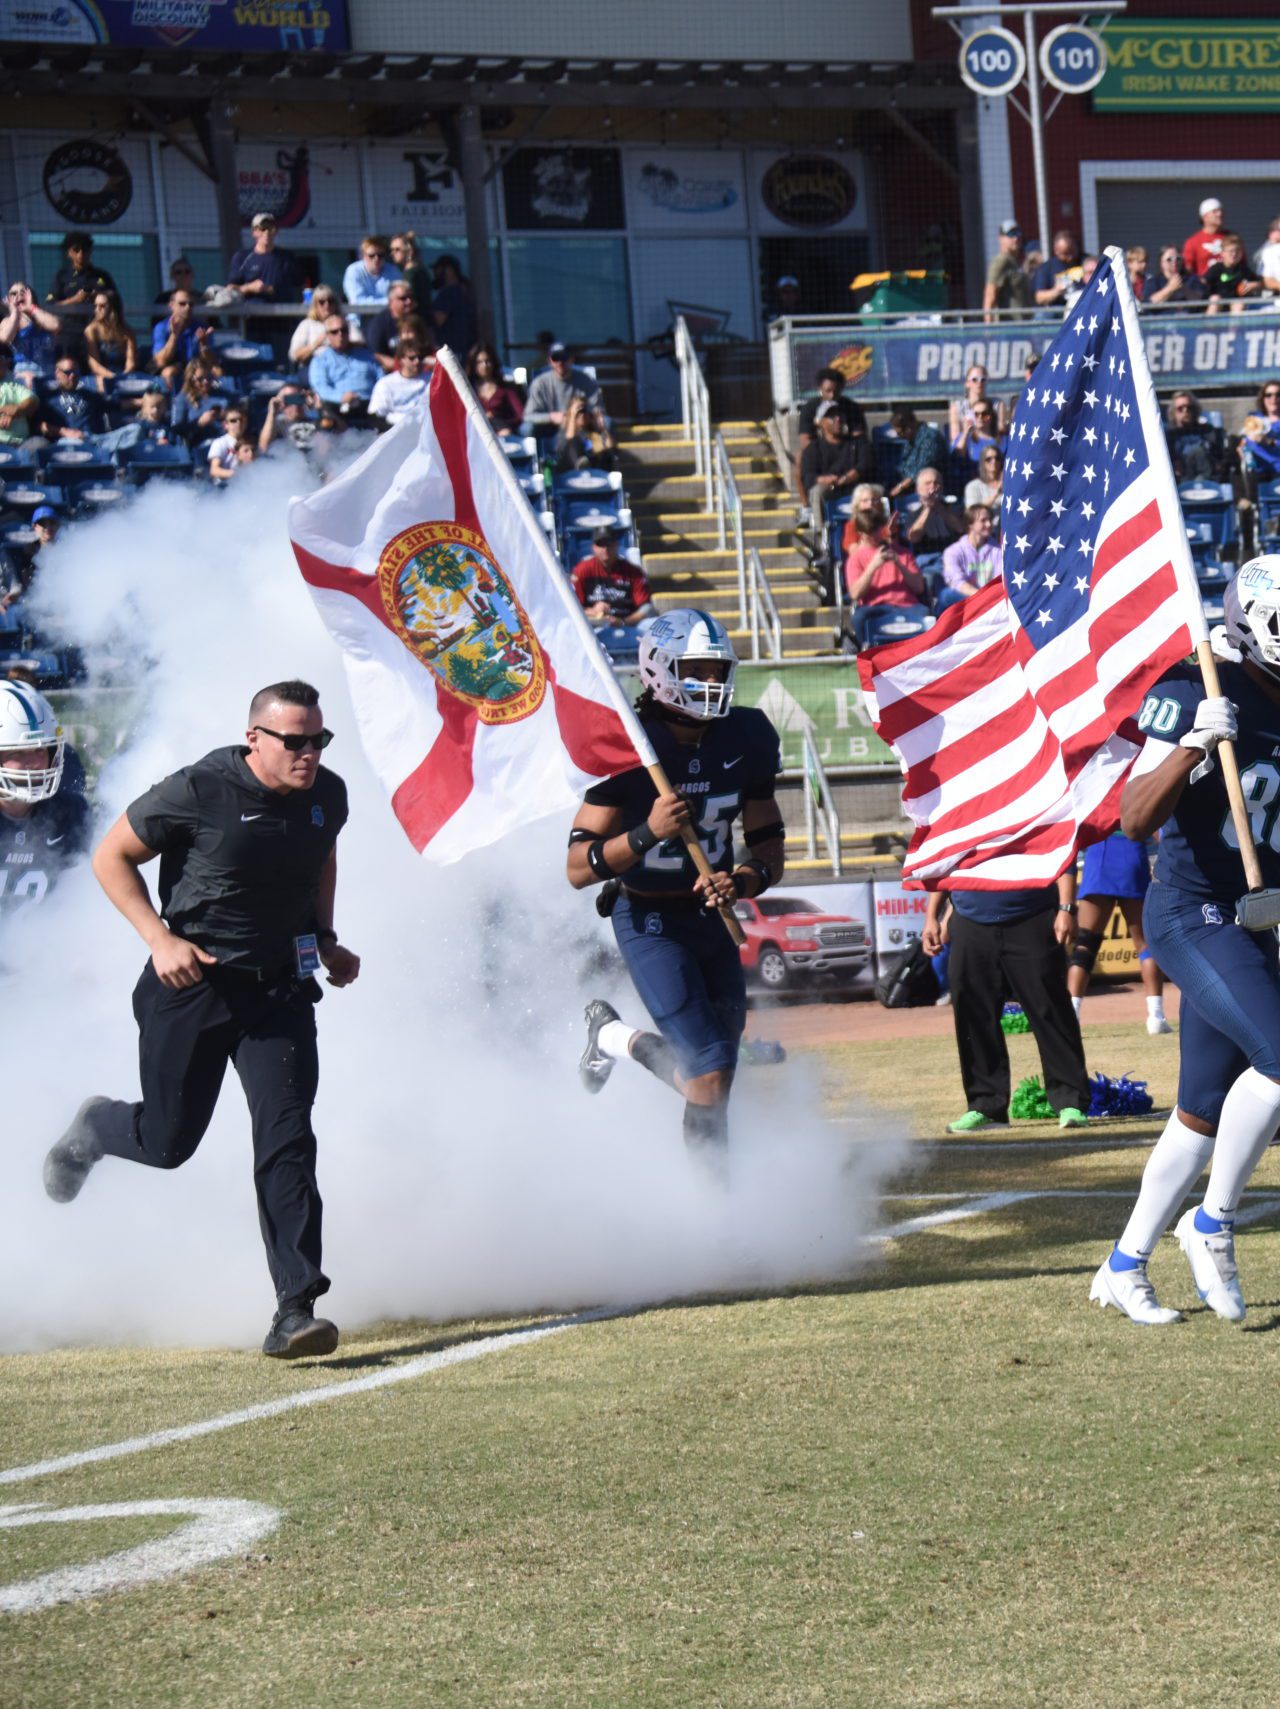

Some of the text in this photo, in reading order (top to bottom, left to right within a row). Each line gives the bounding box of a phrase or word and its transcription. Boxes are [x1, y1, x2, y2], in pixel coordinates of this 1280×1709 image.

[132, 12, 210, 27] DISCOUNT
[234, 7, 330, 29] WORLD
[967, 50, 1011, 72] 100
[1054, 48, 1095, 70] 101
[1122, 75, 1172, 92] IRISH
[1175, 75, 1229, 92] WAKE
[917, 343, 1034, 382] PROUD
[1194, 333, 1236, 370] OF
[1138, 695, 1182, 734] 80
[681, 781, 711, 793] ARGOS
[5, 852, 34, 864] ARGOS
[877, 897, 928, 916] Hill-K
